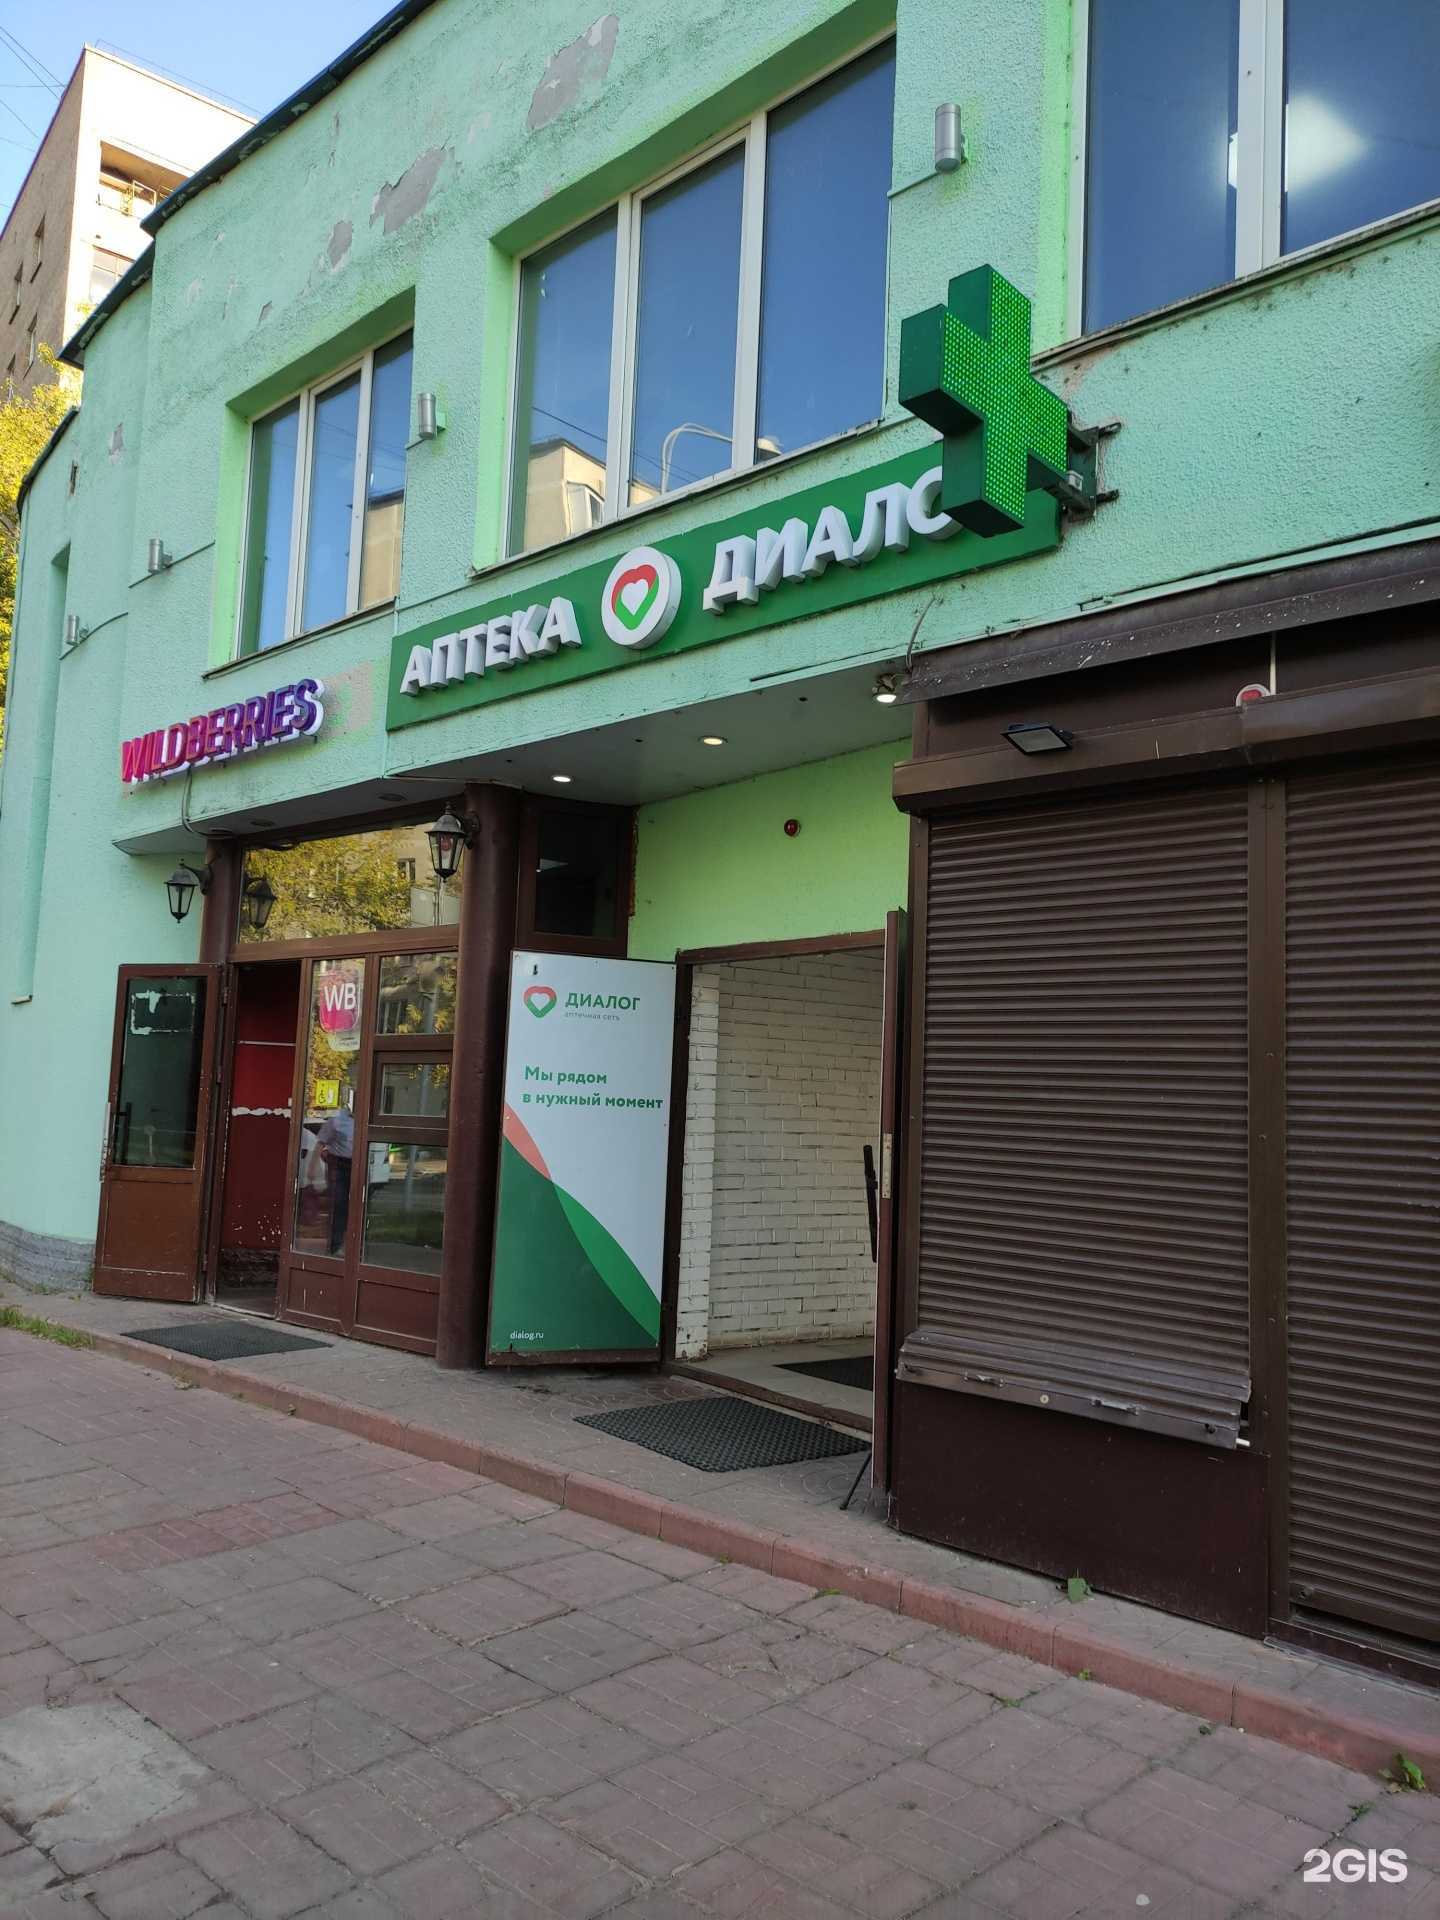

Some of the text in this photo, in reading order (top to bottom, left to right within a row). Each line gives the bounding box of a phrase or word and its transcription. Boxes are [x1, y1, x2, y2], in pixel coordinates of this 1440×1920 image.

[399, 465, 963, 697] АПТЕКА ДИАЛО
[121, 678, 325, 785] WILDBERRIES
[323, 982, 357, 1012] WB
[564, 991, 641, 1011] ДИАЛОГ
[524, 1065, 608, 1086] Мы рядом
[522, 1093, 664, 1110] в нужный момент
[509, 1329, 545, 1341] dialog.ru
